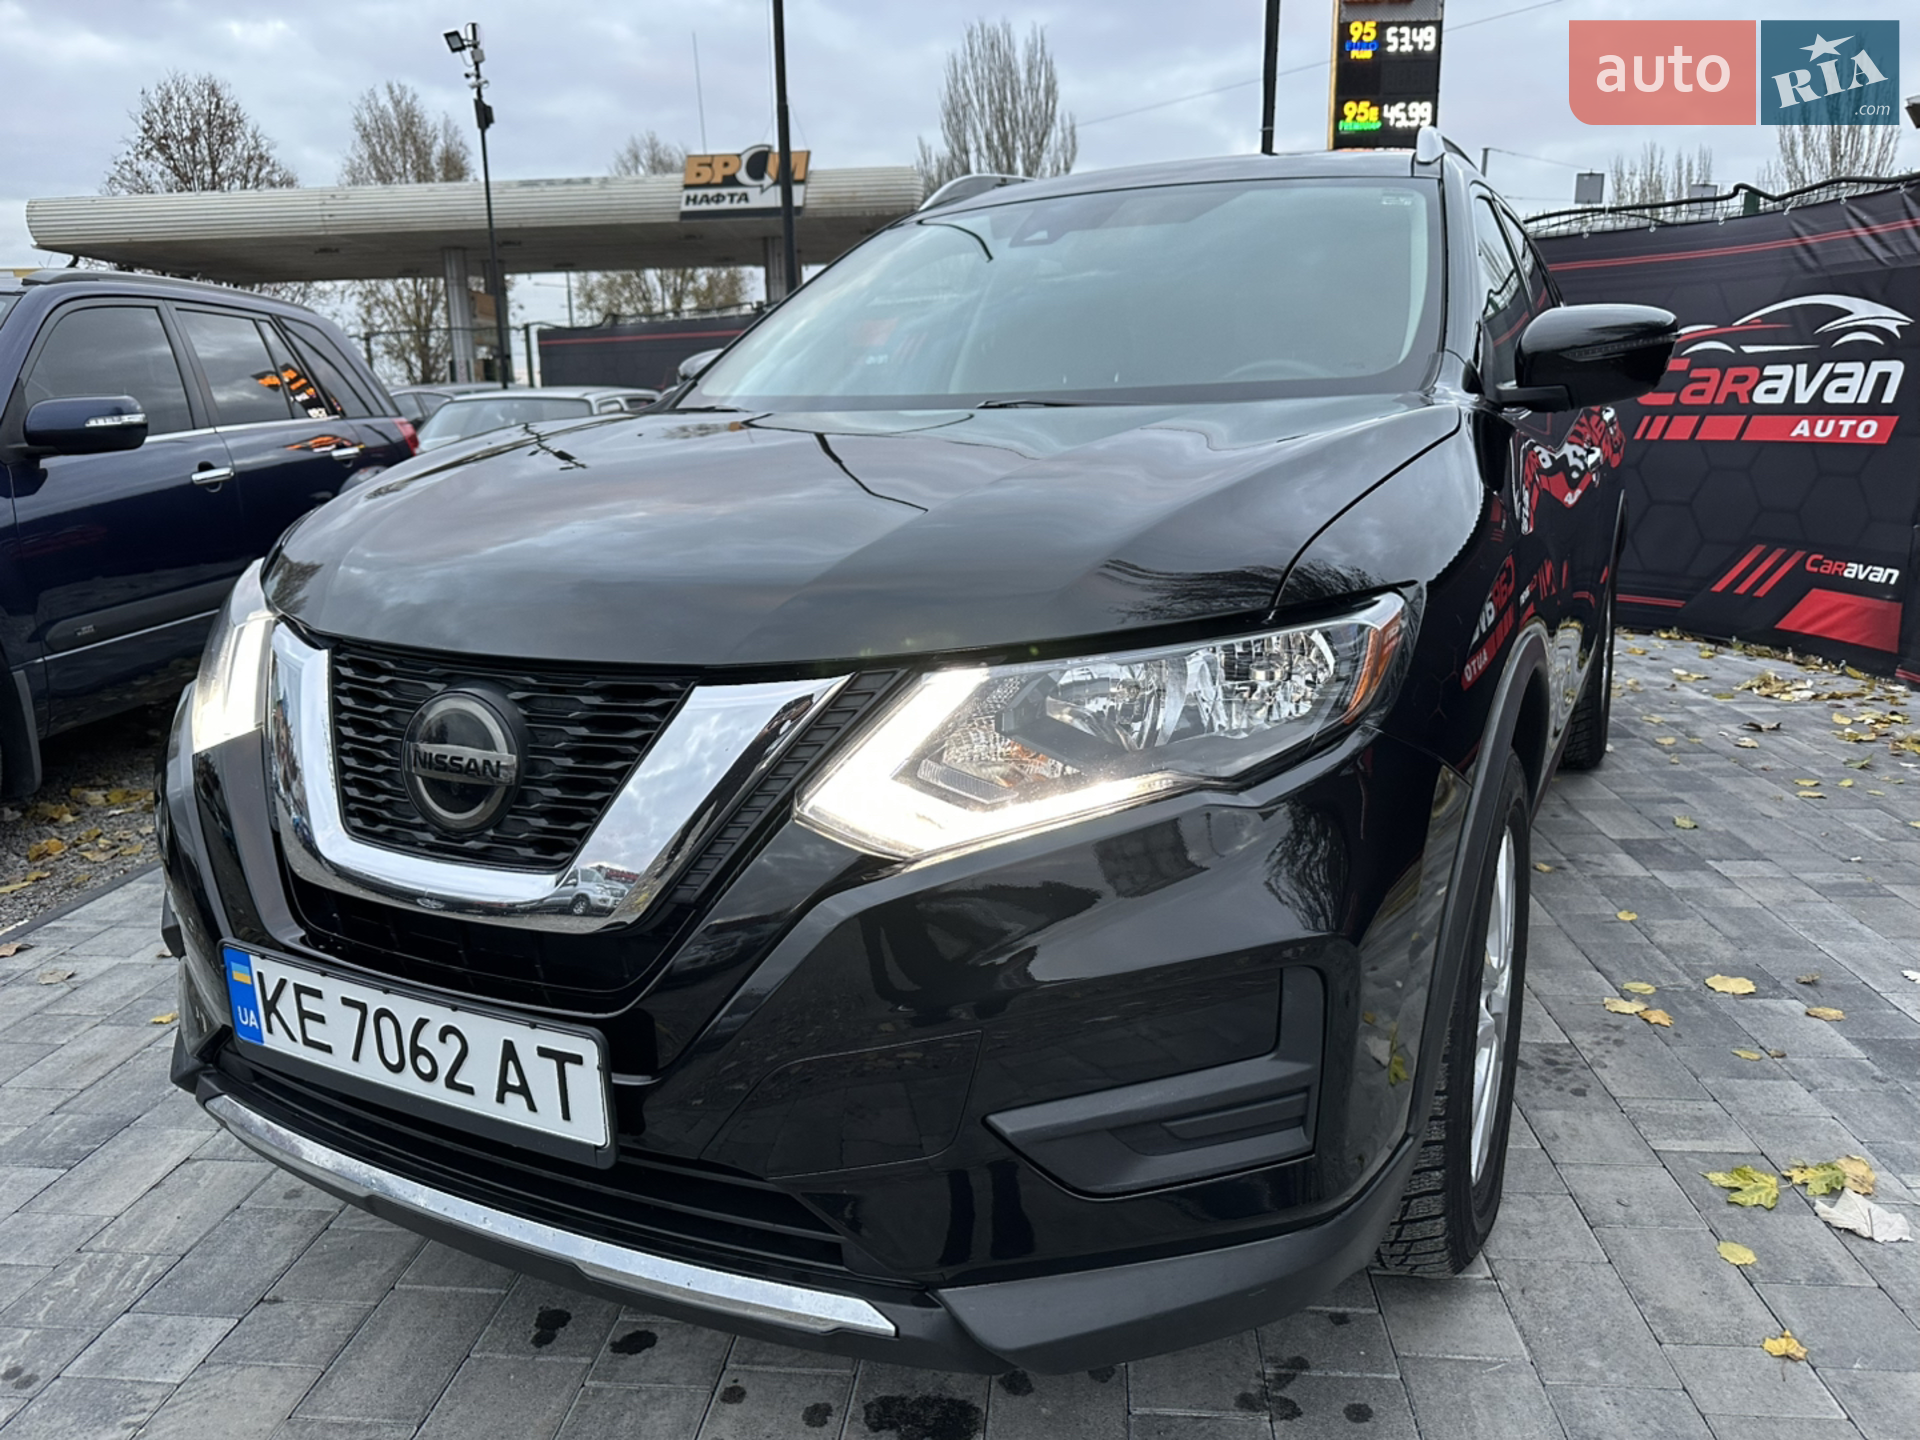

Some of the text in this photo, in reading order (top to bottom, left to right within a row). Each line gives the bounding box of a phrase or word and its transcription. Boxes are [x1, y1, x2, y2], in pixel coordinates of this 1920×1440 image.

[1349, 21, 1436, 52] 95 53.49
[1383, 102, 1432, 128] 45.99
[685, 191, 749, 206] НАФТА
[1790, 419, 1879, 438] AUTO
[413, 746, 501, 778] NISSAN
[237, 1007, 260, 1029] UA
[257, 971, 584, 1122] KE 7062 AT
